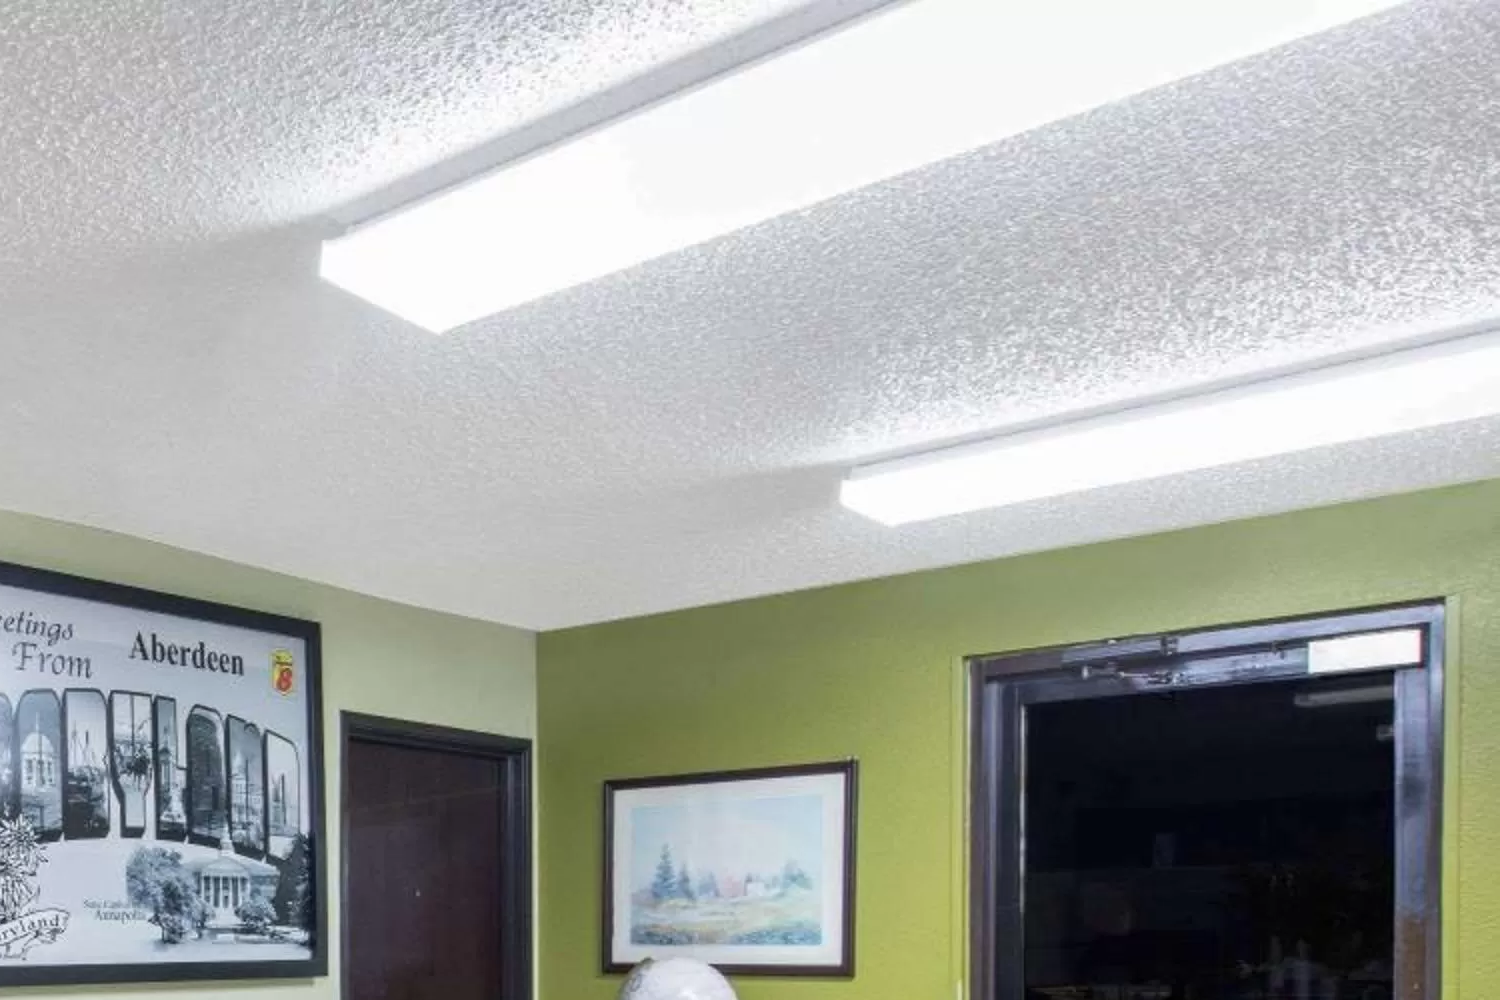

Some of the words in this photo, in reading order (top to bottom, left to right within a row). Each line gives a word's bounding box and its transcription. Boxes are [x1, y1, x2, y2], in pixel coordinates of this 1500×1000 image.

[11, 641, 94, 679] From
[128, 630, 245, 676] Aberdeen
[275, 667, 292, 691] 8
